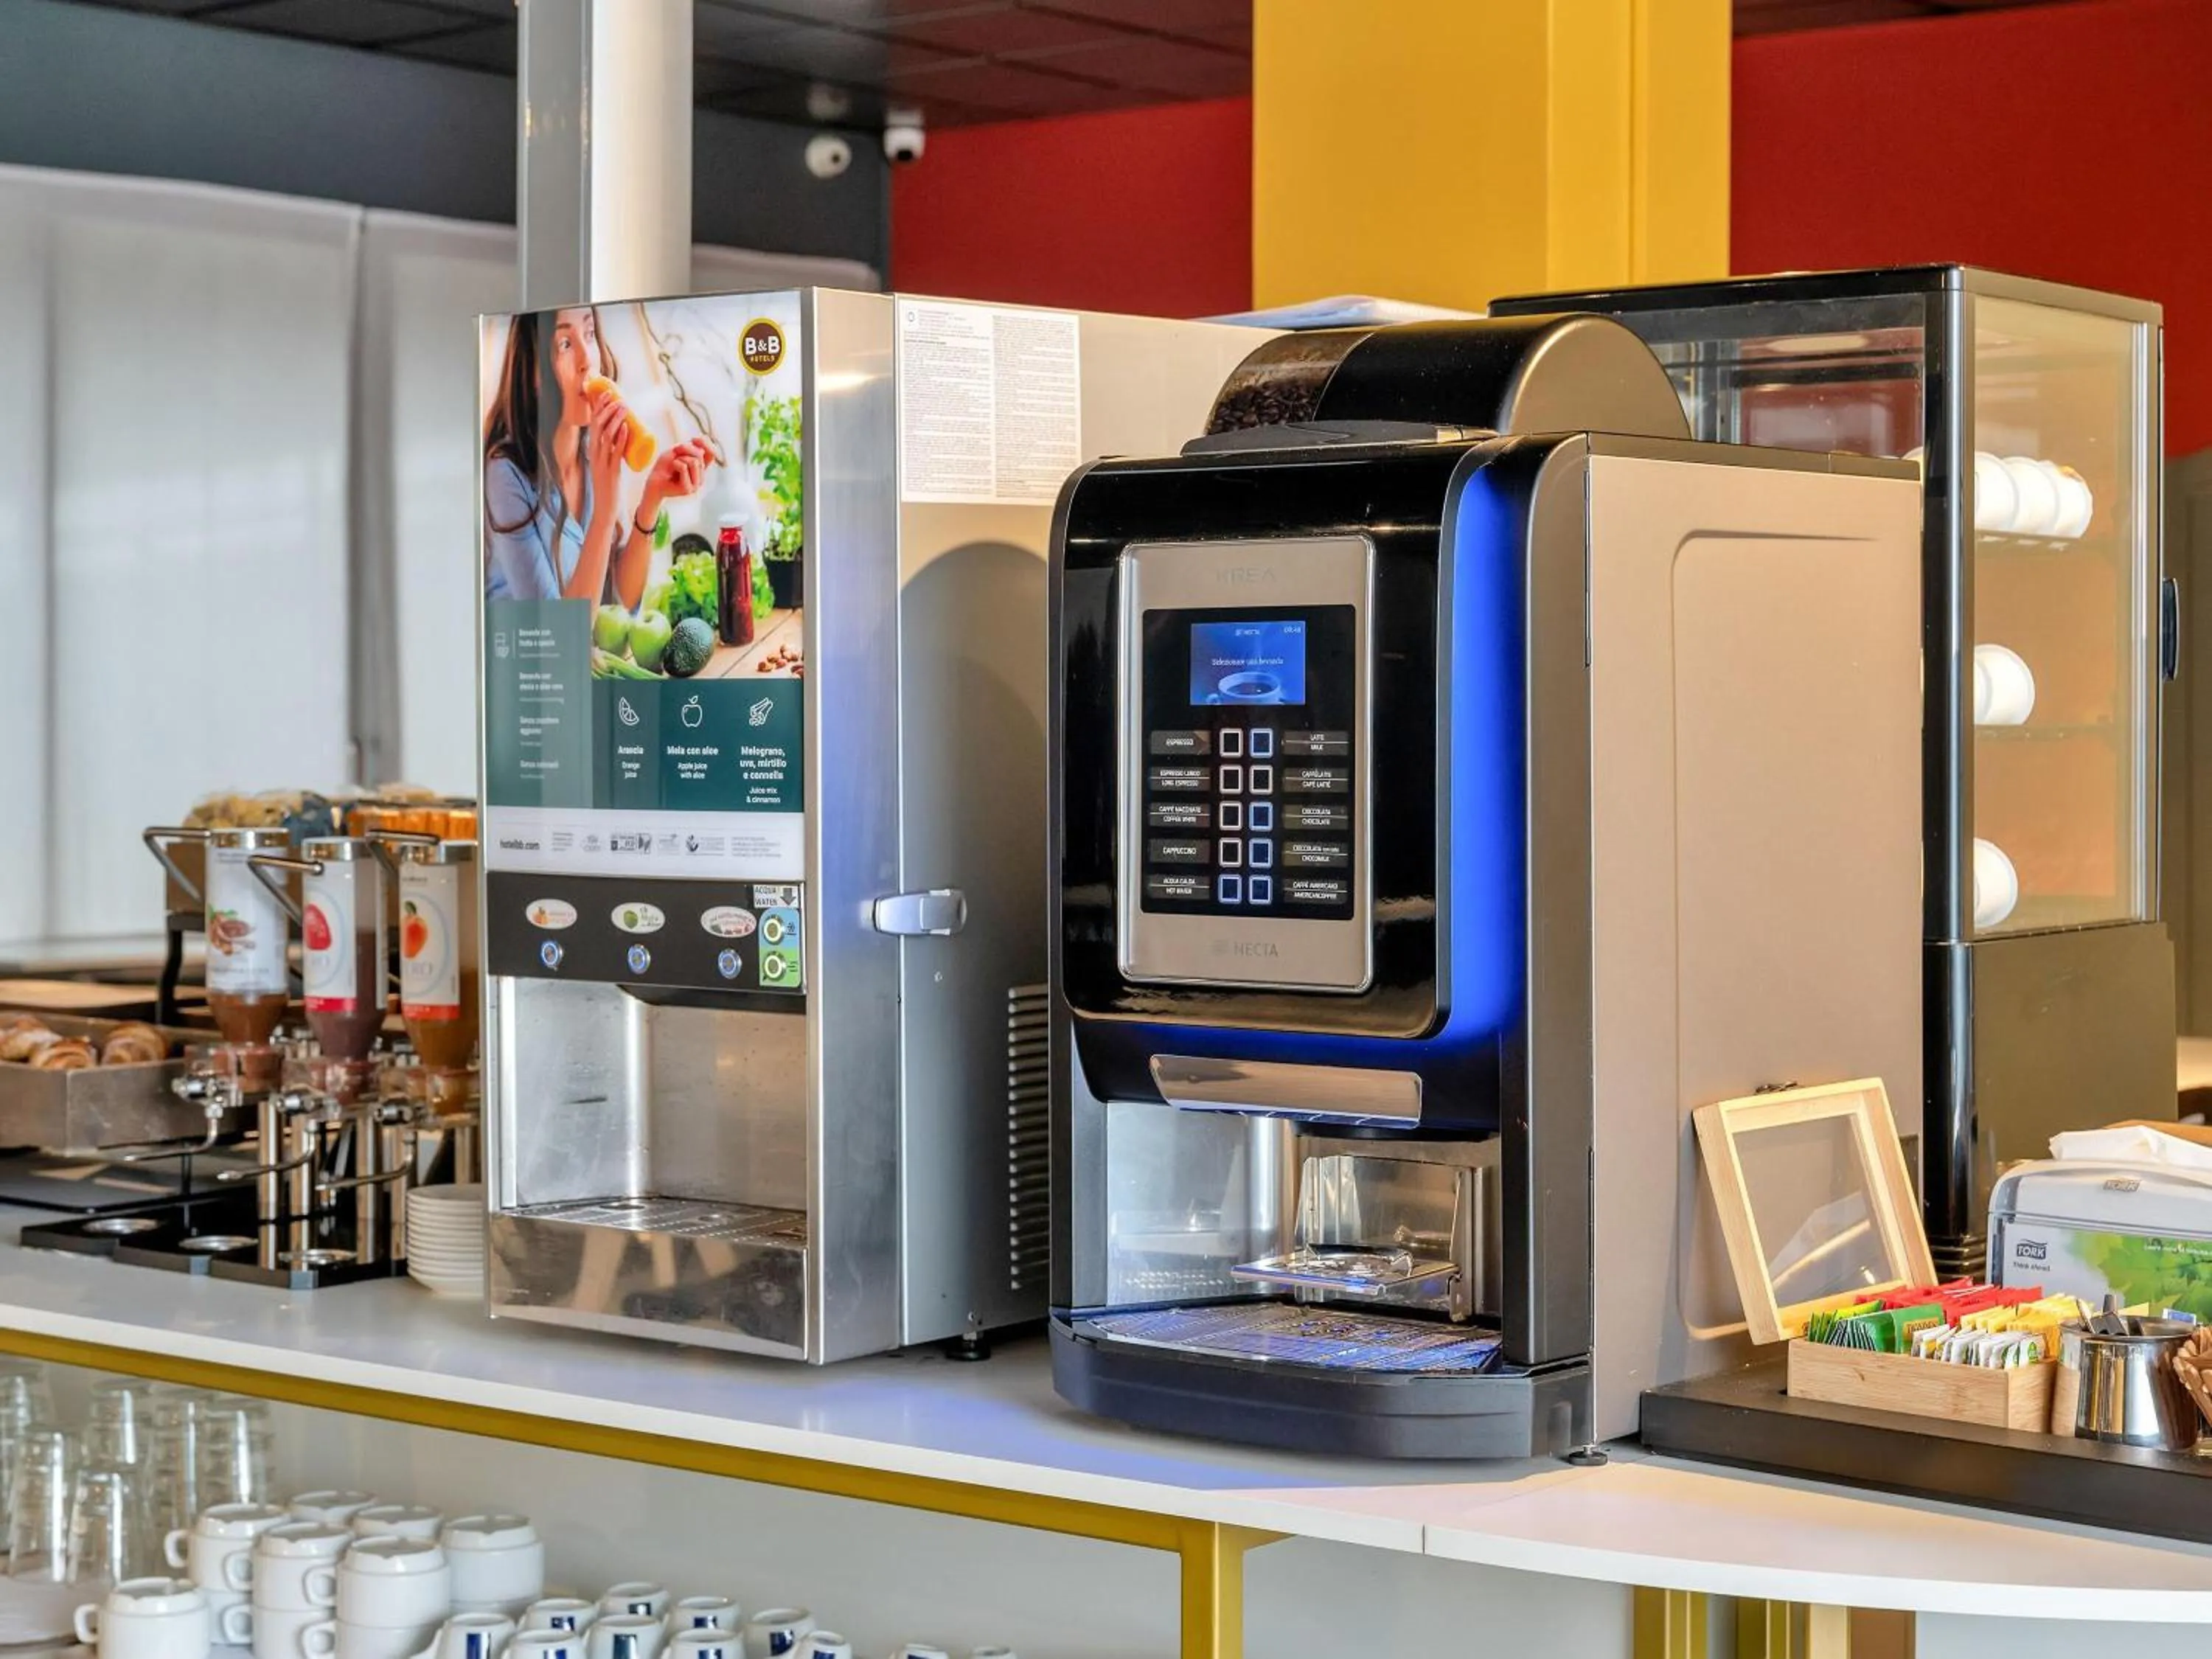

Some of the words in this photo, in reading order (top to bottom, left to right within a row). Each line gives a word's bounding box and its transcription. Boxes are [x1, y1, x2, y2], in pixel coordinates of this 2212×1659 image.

[745, 335, 780, 355] B&B
[618, 745, 644, 754] Arancia
[667, 745, 685, 755] Mela
[686, 747, 700, 755] con
[702, 745, 718, 755] aloe
[741, 746, 786, 757] Melograno,
[758, 758, 787, 768] mirtillo
[750, 771, 784, 780] cannella
[1163, 846, 1197, 855] CAPPUCCINO
[755, 886, 776, 894] ACQUA
[755, 897, 777, 906] WATER
[1234, 942, 1279, 957] NECTA
[2018, 1245, 2045, 1258] TORK
